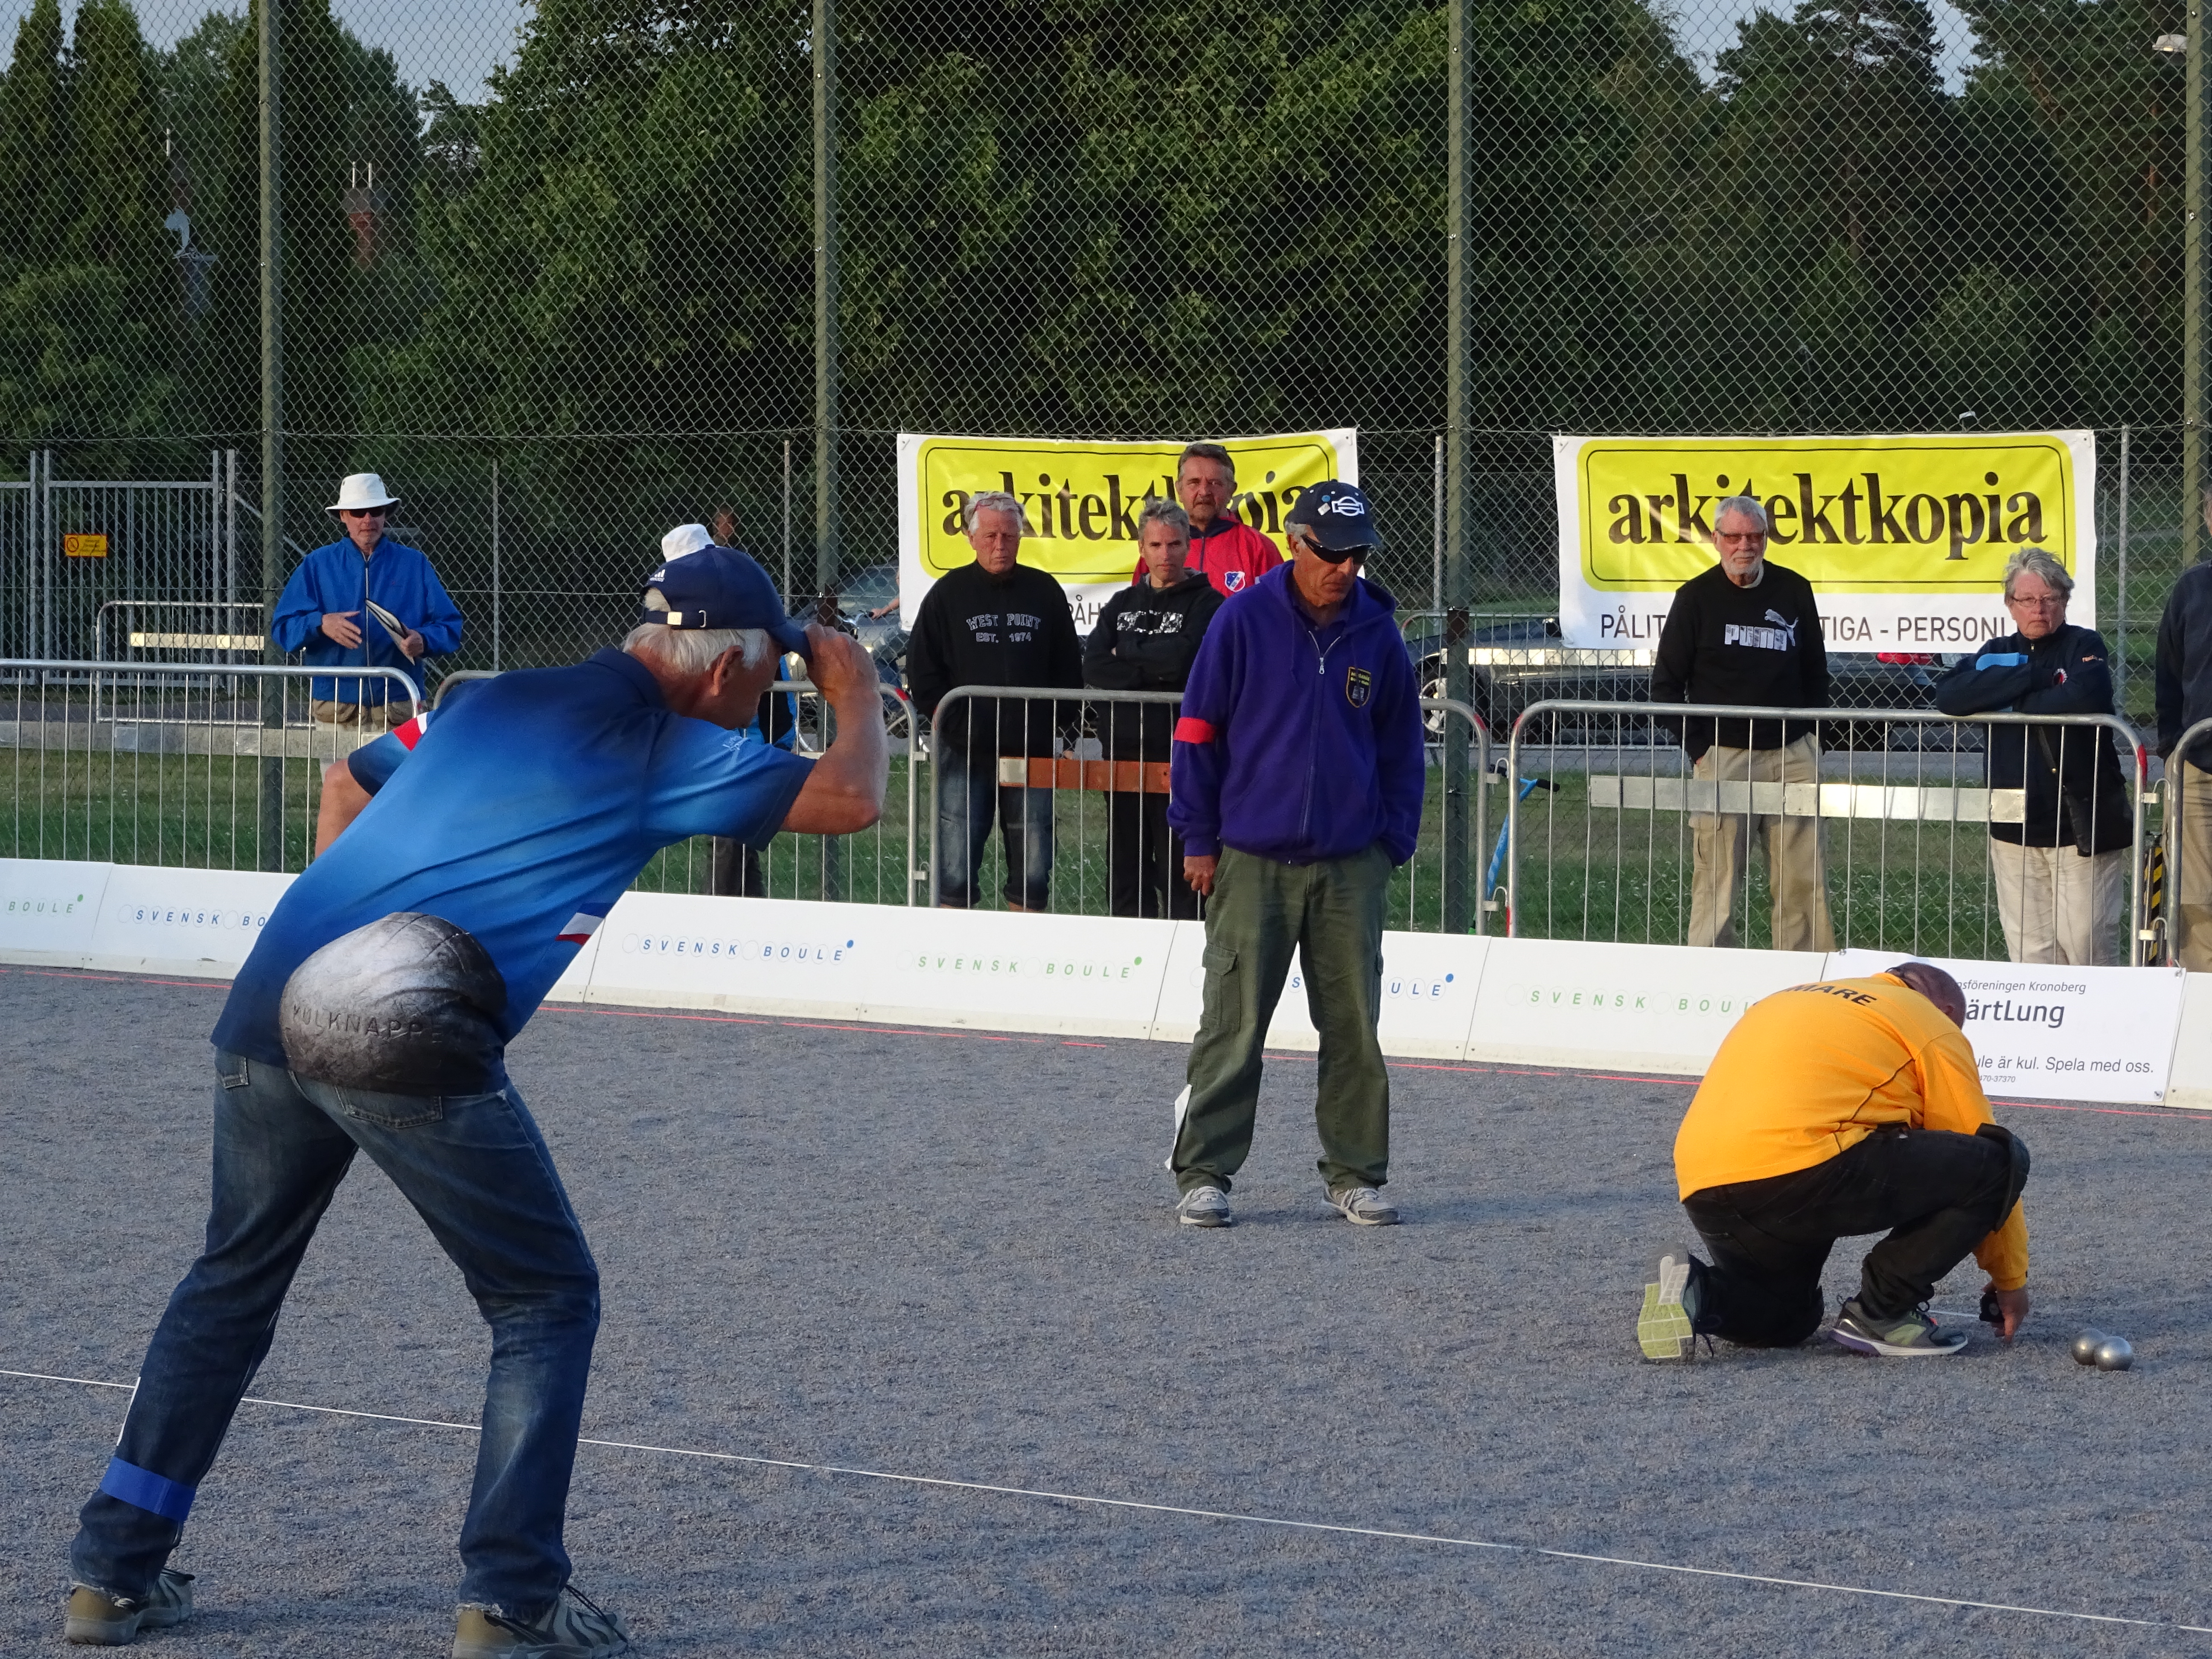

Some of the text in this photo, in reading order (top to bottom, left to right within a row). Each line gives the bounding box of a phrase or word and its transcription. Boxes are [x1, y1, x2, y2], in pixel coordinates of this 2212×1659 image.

[966, 613, 1041, 631] WEST POINT
[976, 632, 999, 643] EST.
[1724, 624, 1787, 652] PUMA
[8, 901, 73, 914] BOULE
[136, 909, 220, 925] SVENSK
[643, 938, 843, 961] SVENSK BOULE
[918, 956, 1130, 978] SVENSK BOULE
[2029, 981, 2086, 995] Kronoberg
[1531, 990, 1645, 1008] SVENSK
[1997, 1056, 2012, 1069] är
[2016, 1056, 2039, 1070] kul.
[2046, 1057, 2085, 1074] Spela
[2090, 1059, 2121, 1072] med
[2125, 1062, 2154, 1073] oss.
